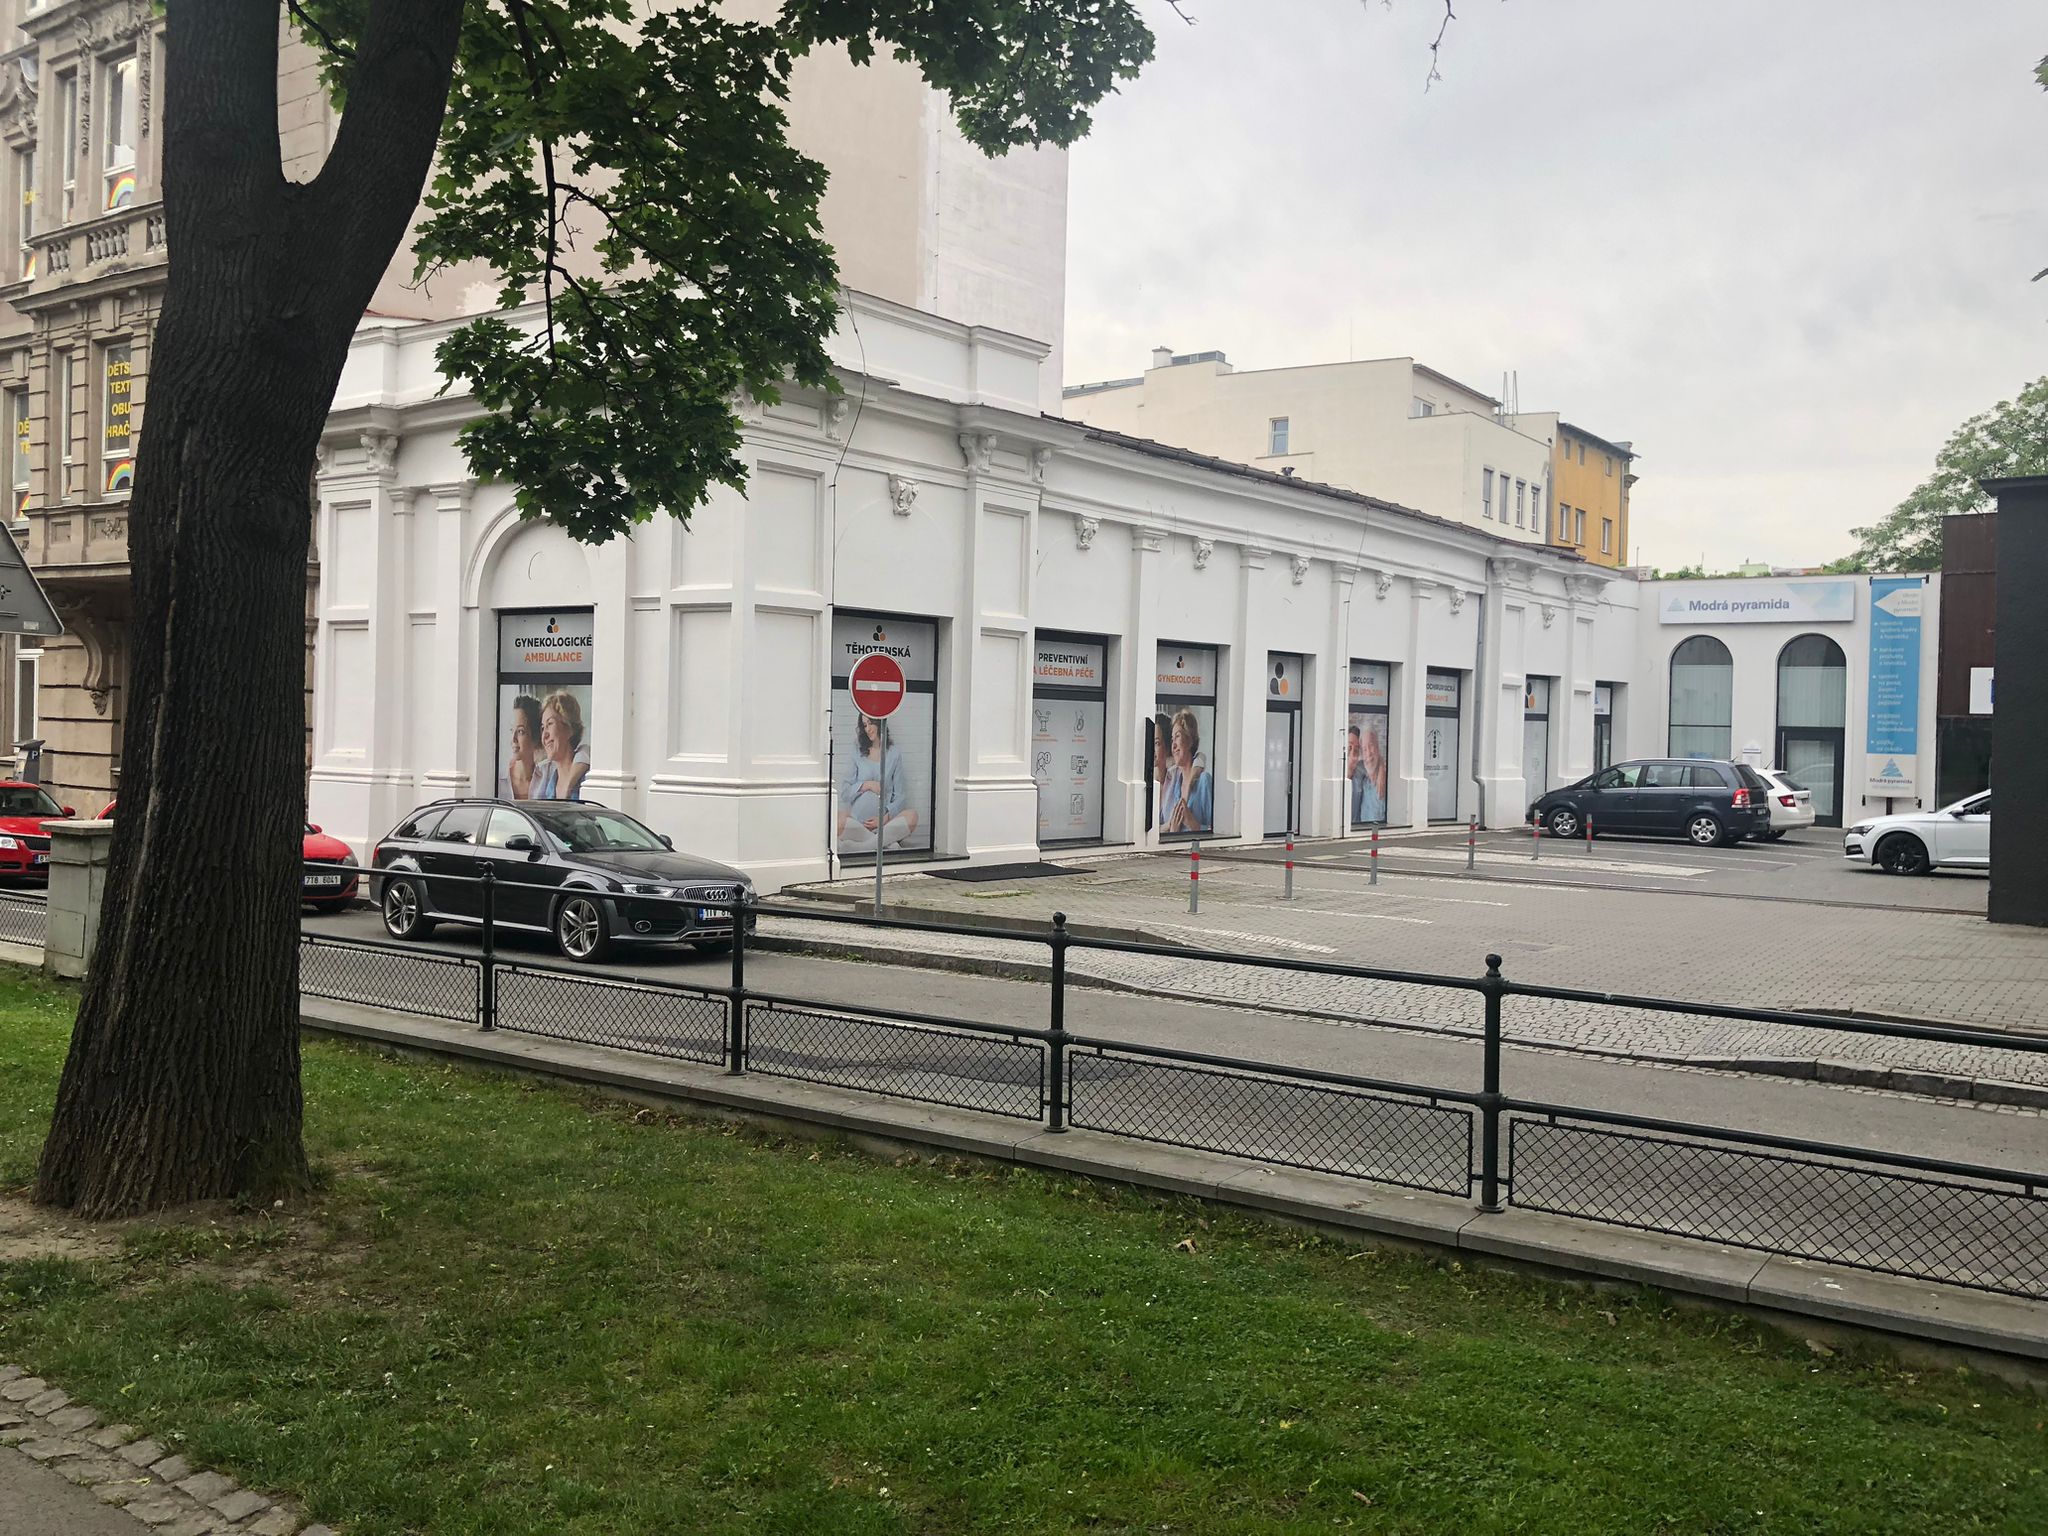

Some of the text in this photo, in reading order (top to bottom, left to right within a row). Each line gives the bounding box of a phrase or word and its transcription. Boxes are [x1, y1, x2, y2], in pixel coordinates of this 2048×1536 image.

[107, 361, 130, 376] DĚTS
[112, 402, 132, 416] OBU
[106, 421, 131, 438] HRAČ
[1689, 598, 1790, 612] Modrá pyramida
[515, 634, 592, 648] GYNEKOLOGICKÉ
[524, 652, 582, 662] AMBULANCE
[1038, 653, 1088, 665] PREVENTIVNÍ
[1039, 665, 1073, 677] LÉČEBNÁ
[1075, 667, 1094, 678] PÉČE
[1157, 674, 1202, 684] GYNEKOLOGIE
[32, 750, 38, 760] P
